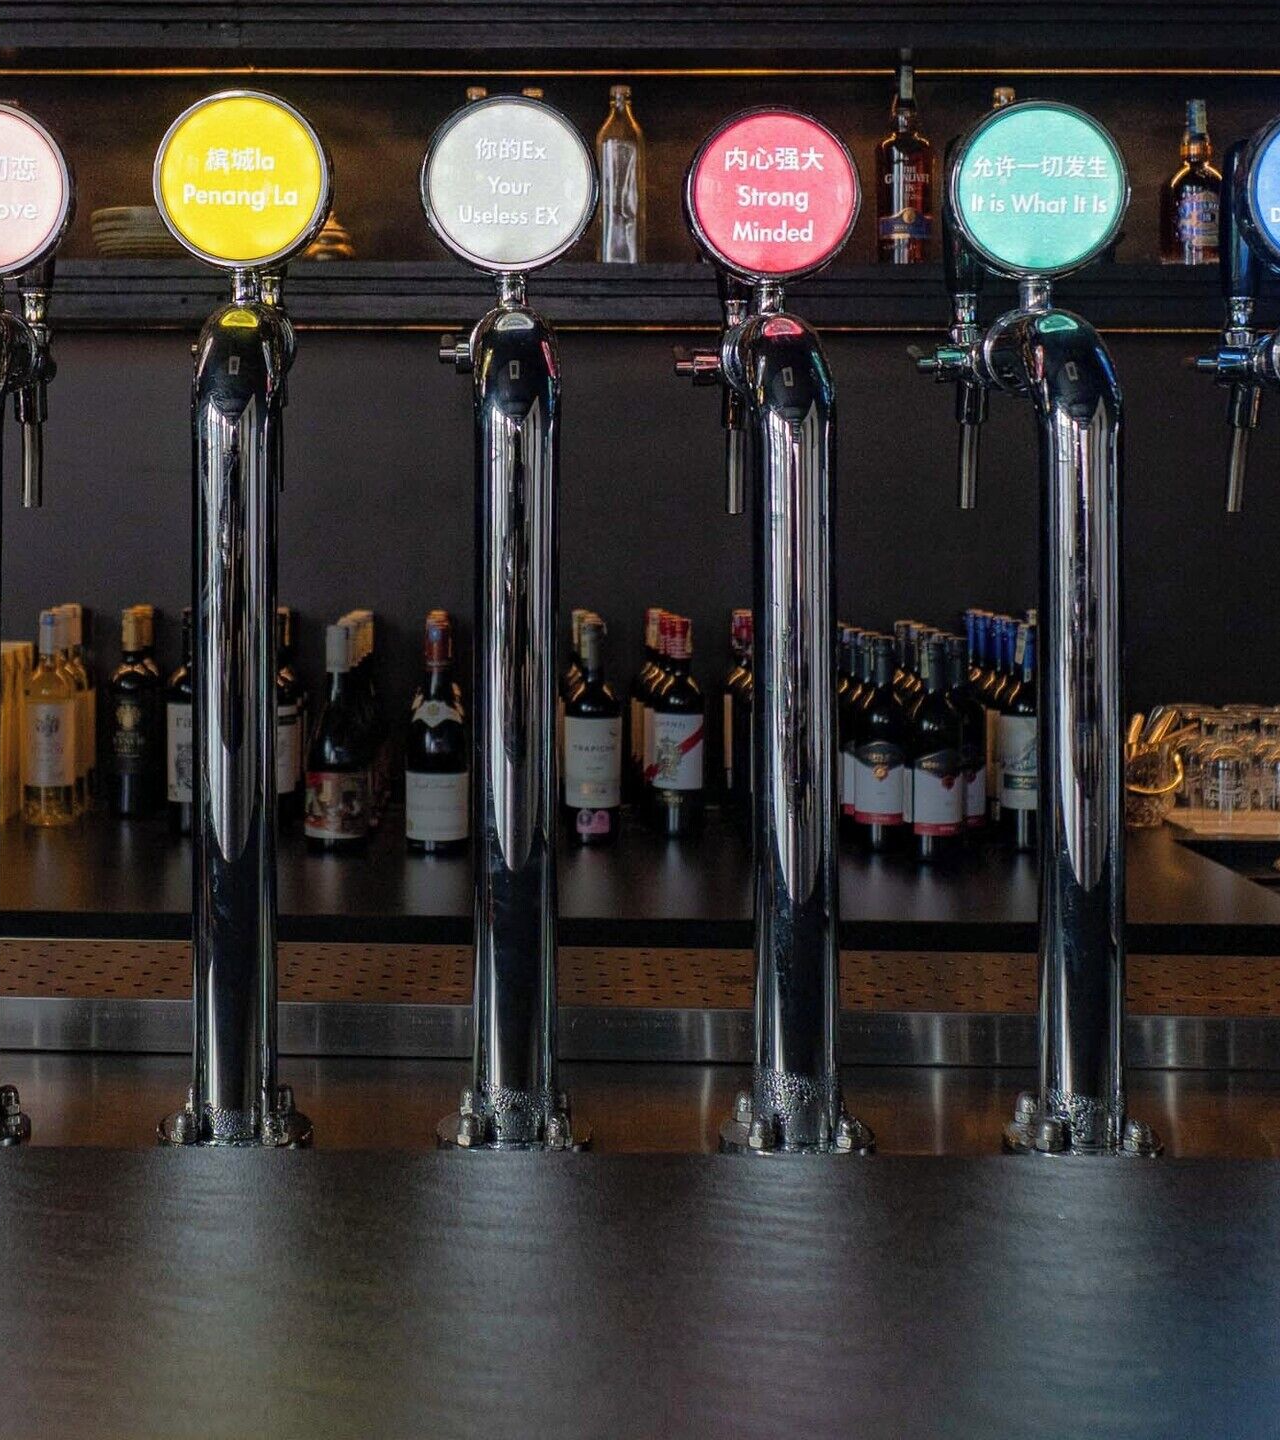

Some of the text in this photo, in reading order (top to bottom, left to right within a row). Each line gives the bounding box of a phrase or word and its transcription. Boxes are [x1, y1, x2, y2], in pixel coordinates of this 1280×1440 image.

[475, 137, 547, 161] 你的Ex
[724, 146, 825, 172] 内心强大
[971, 155, 1108, 178] 允许一切发生
[183, 183, 299, 212] Penang La
[488, 176, 533, 196] Your
[737, 184, 810, 213] Strong
[971, 193, 1108, 214] It is What It Is
[459, 204, 561, 225] Useless EX
[732, 219, 814, 242] Minded
